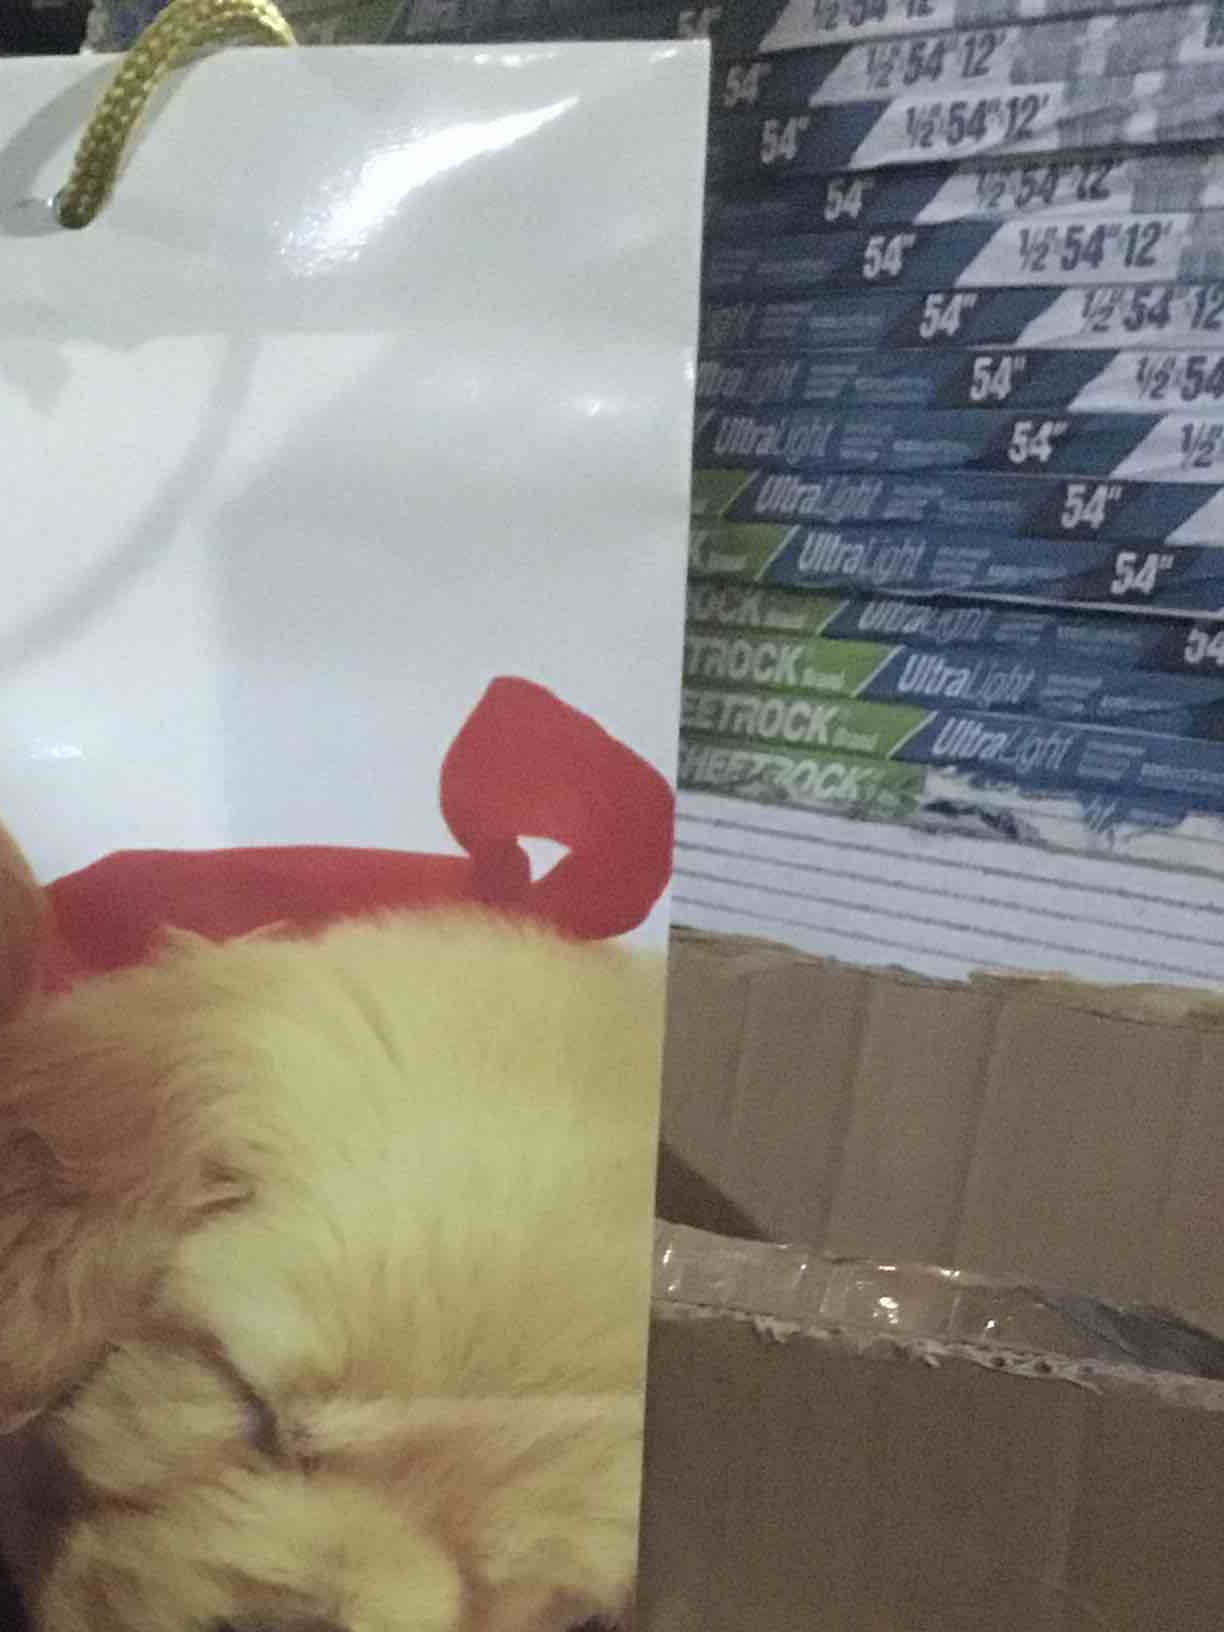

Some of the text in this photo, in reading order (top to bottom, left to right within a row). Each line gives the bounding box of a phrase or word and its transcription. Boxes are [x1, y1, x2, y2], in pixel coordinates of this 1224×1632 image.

[970, 356, 1027, 401] 54"
[1007, 420, 1068, 464] 54"
[1060, 484, 1124, 529] 54"
[798, 530, 928, 584] UltraLight
[1110, 551, 1177, 595] 54"
[897, 654, 1036, 708] UltraLight
[932, 716, 1076, 776] UltraLight
